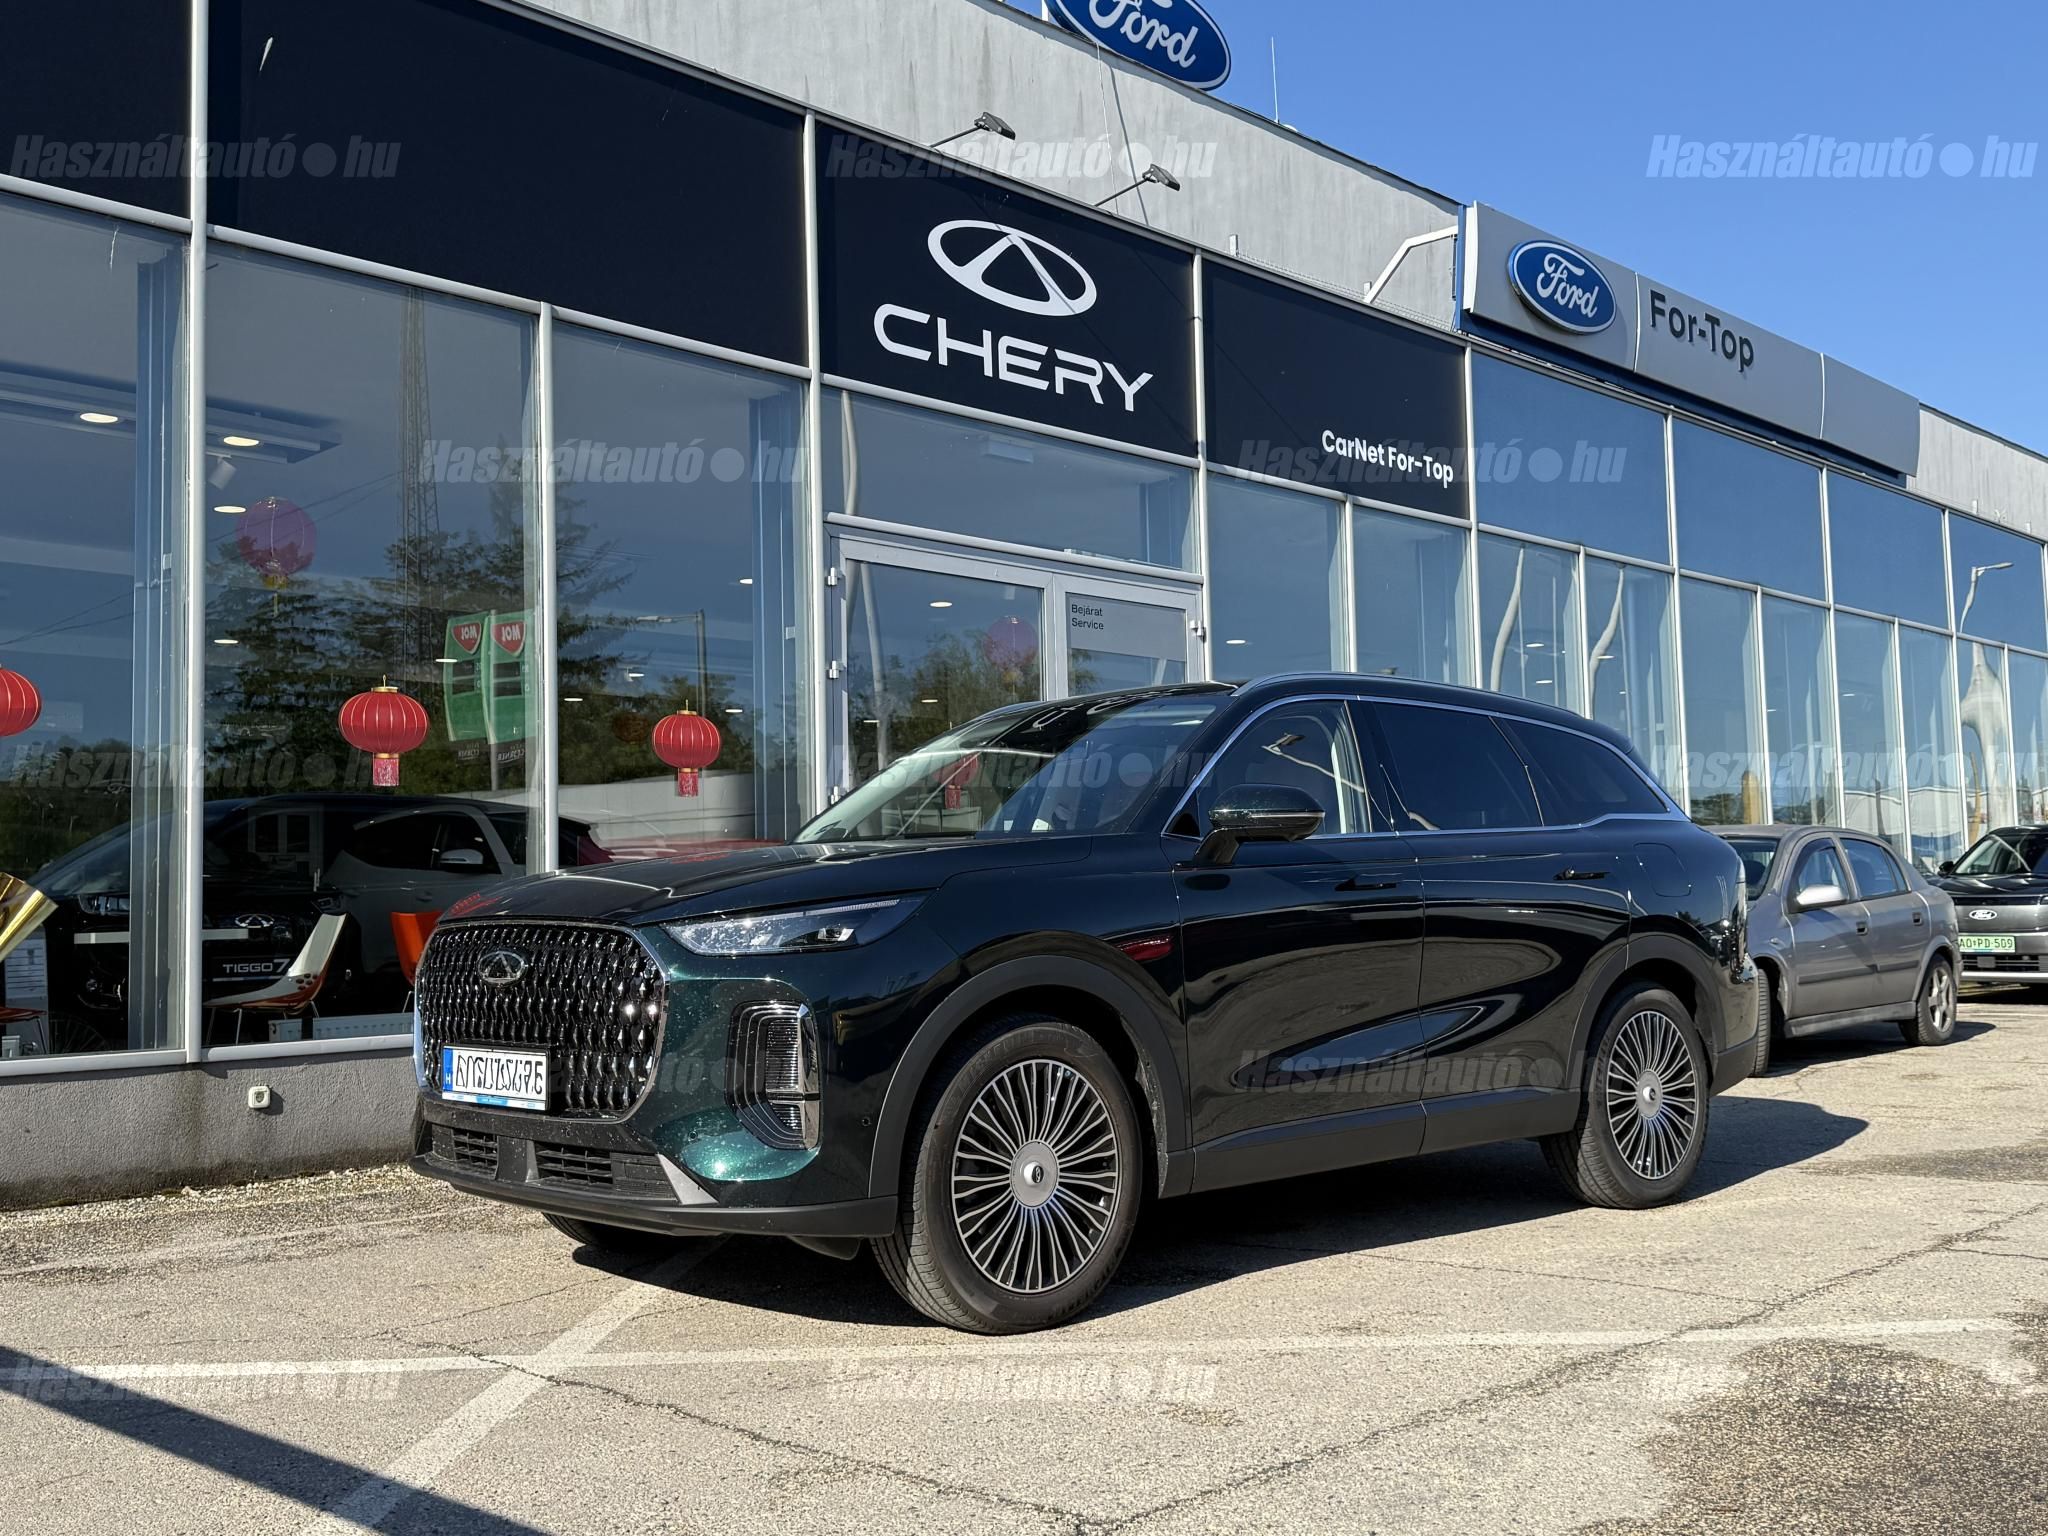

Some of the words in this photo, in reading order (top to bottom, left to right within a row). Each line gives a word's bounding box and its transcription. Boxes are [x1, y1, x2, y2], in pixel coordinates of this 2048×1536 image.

[1536, 253, 1599, 318] Ford
[874, 303, 1153, 412] CHERY
[1650, 289, 1754, 373] For-Top
[1322, 430, 1385, 466] CarNet
[1388, 446, 1453, 488] For-Top
[1071, 604, 1103, 617] Bejárat
[1071, 617, 1104, 630] Service
